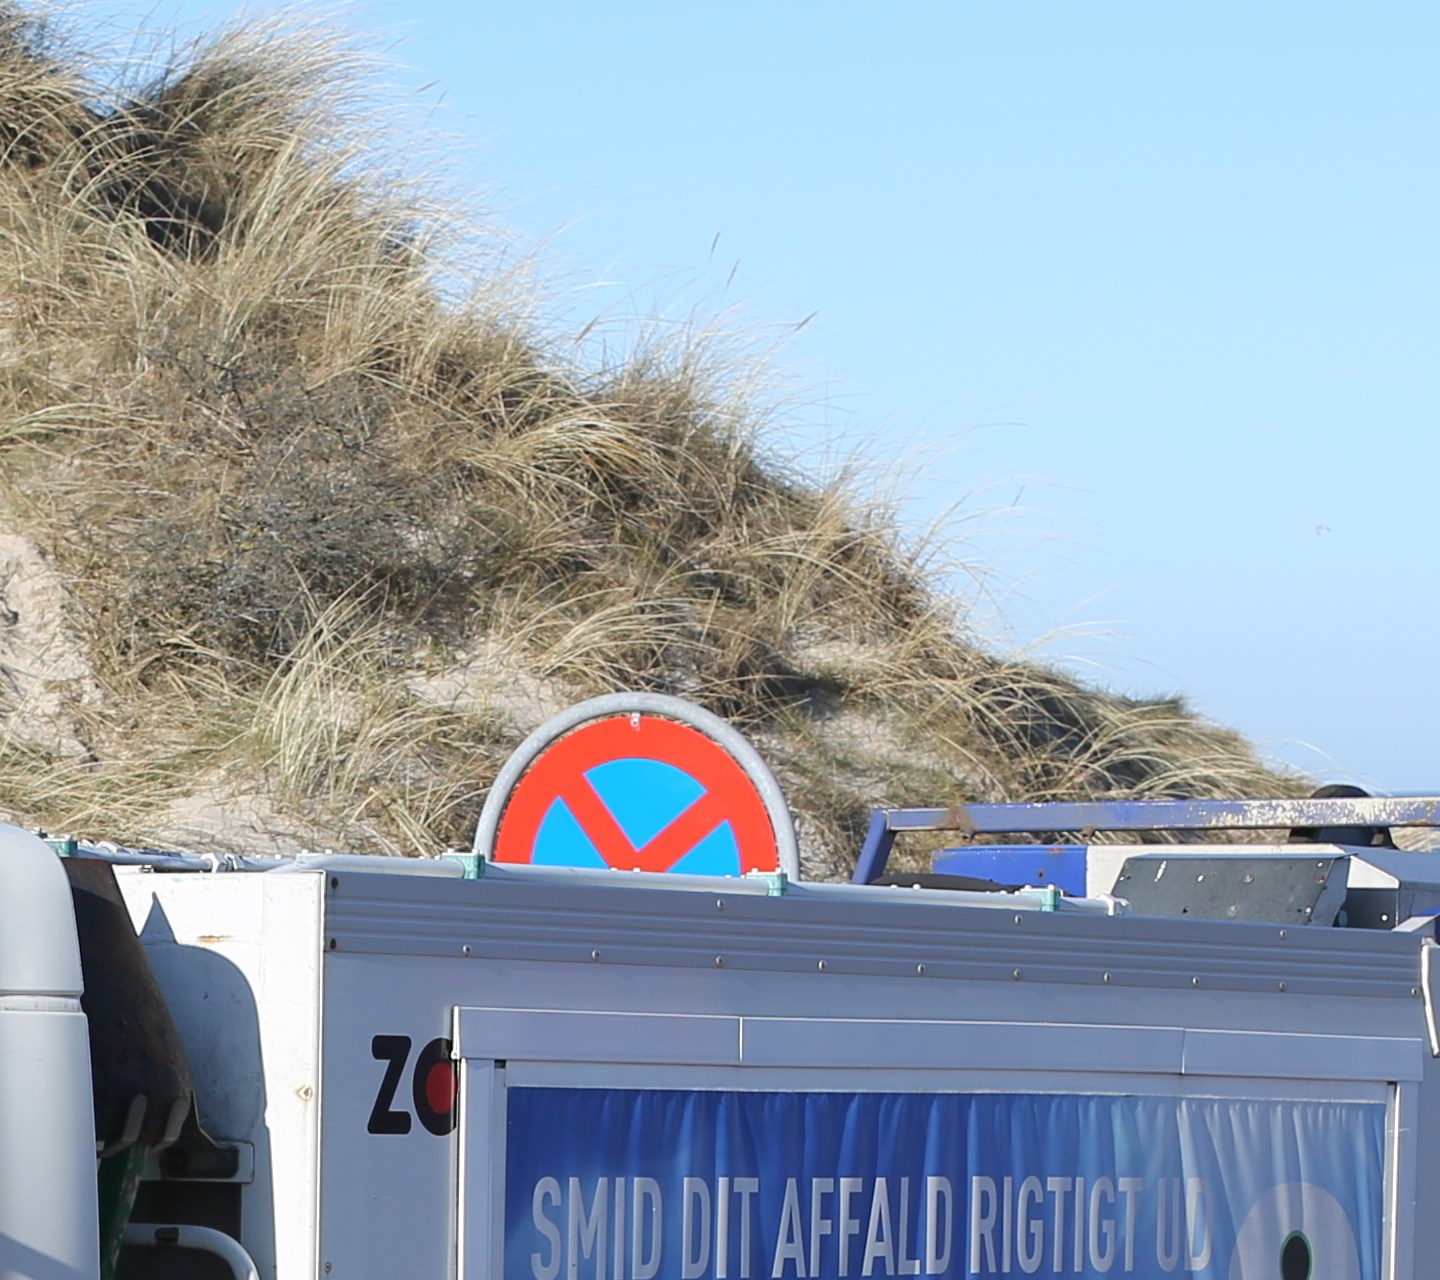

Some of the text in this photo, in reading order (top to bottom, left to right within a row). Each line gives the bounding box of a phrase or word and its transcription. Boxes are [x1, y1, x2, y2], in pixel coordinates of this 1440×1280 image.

[681, 1176, 759, 1280] DIT
[771, 1175, 953, 1279] AFFALD
[970, 1175, 1143, 1275] RIGTIGT
[1156, 1176, 1214, 1272] UD
